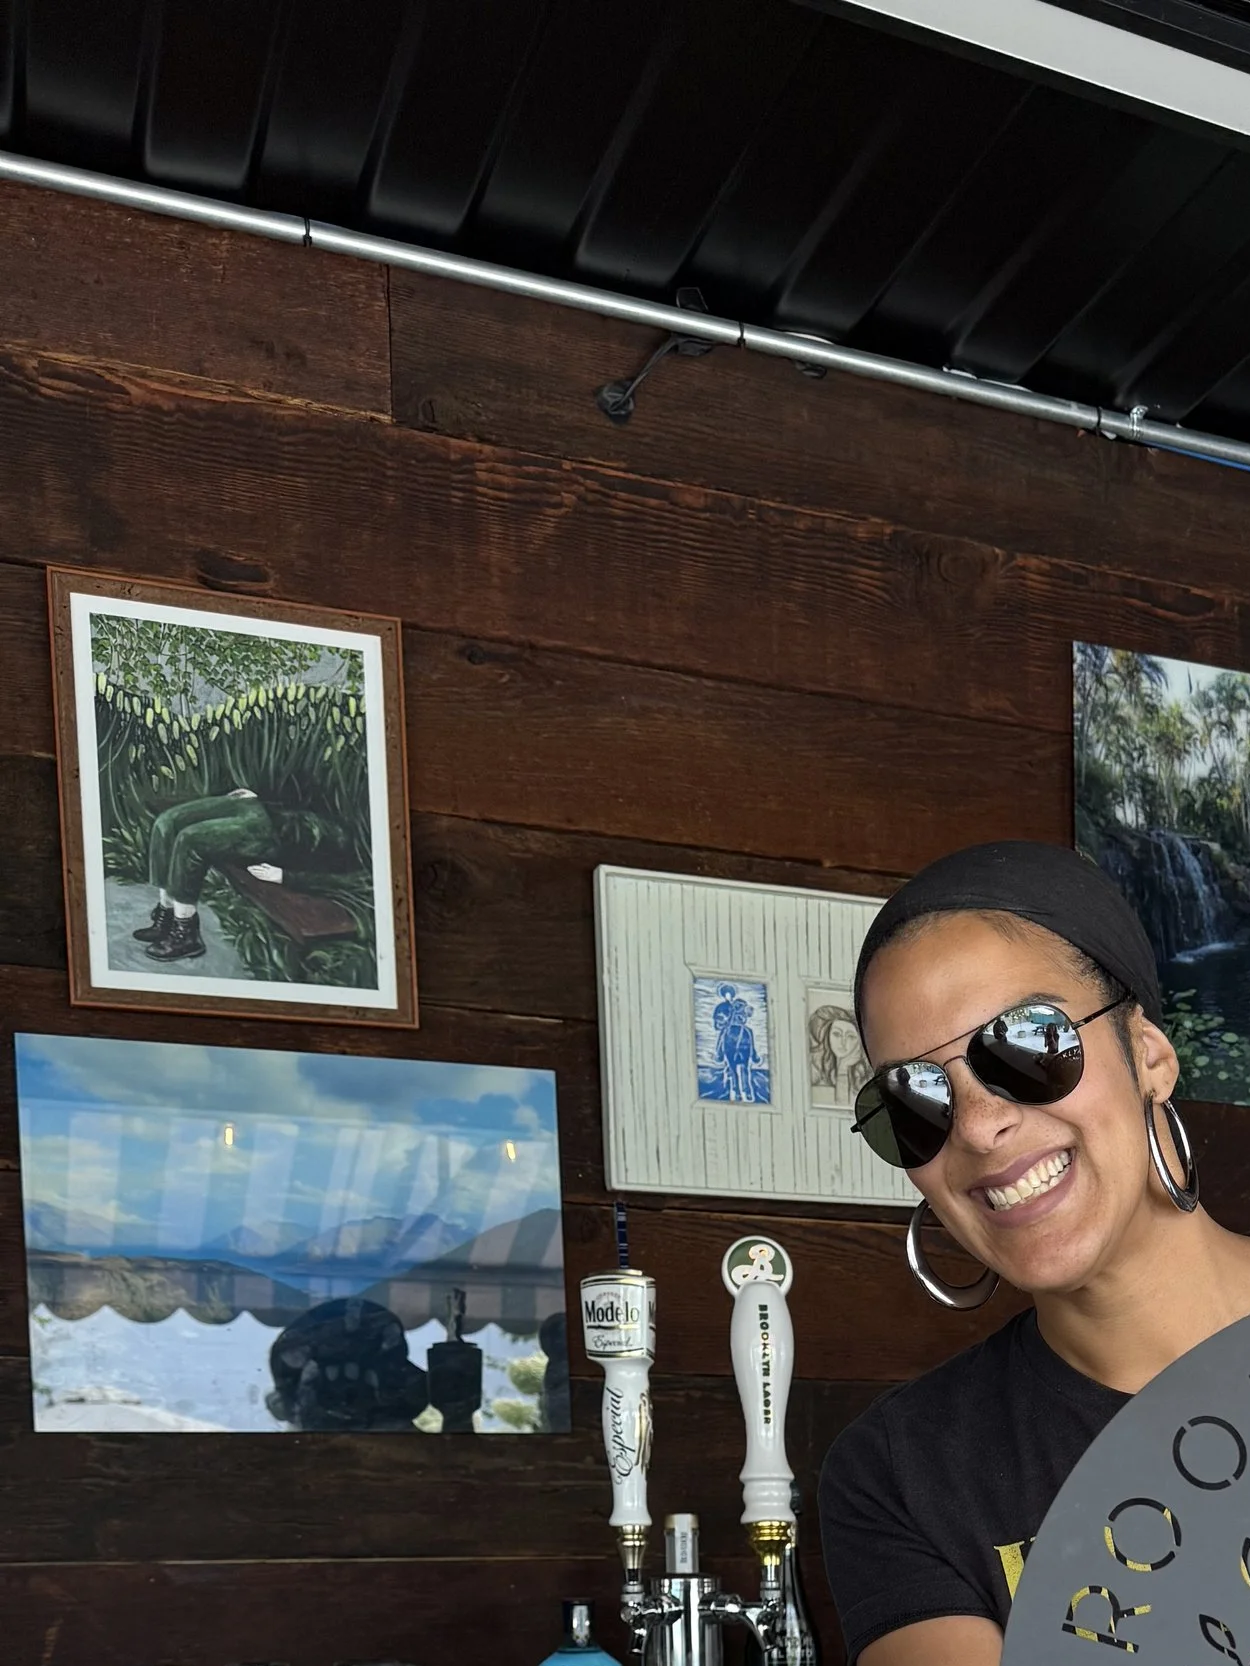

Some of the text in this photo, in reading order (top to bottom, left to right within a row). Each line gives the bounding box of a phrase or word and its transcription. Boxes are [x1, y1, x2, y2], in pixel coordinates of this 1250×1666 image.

[584, 1300, 640, 1324] Modelo
[758, 1303, 772, 1425] BROOKLYN LAGER
[605, 1385, 635, 1485] Especial
